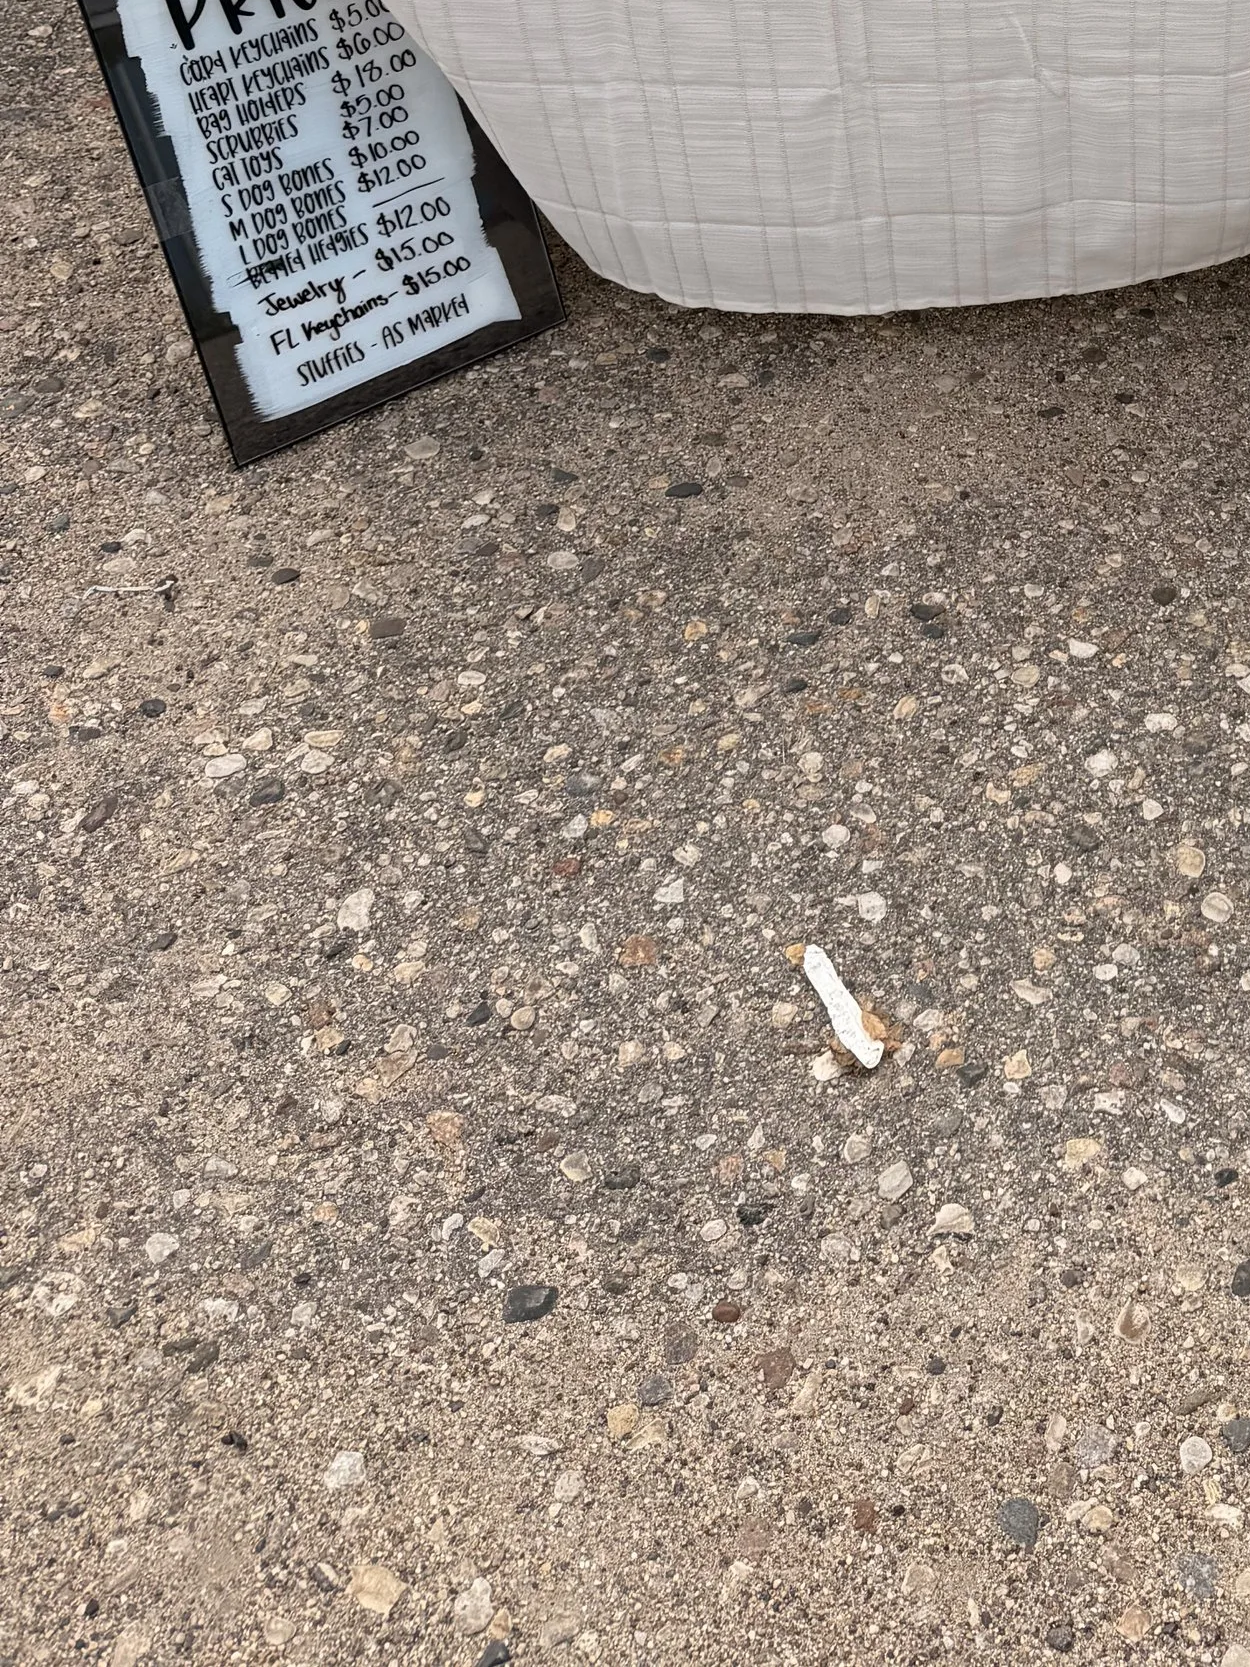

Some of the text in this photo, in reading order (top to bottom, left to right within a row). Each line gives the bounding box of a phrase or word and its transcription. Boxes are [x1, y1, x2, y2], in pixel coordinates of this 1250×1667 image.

[335, 21, 406, 62] $6.00
[340, 84, 405, 118] $5.00
[342, 106, 409, 140] $7.00
[221, 193, 233, 218] S
[348, 130, 420, 168] $10.00
[229, 218, 249, 241] M
[357, 154, 427, 193] $12.00
[376, 196, 451, 238] $12.00
[239, 245, 251, 266] L
[257, 276, 346, 316] Jewelry
[375, 231, 455, 272] $15.00
[269, 329, 300, 356] FL
[402, 255, 471, 296] $15.00
[382, 321, 404, 350] AS
